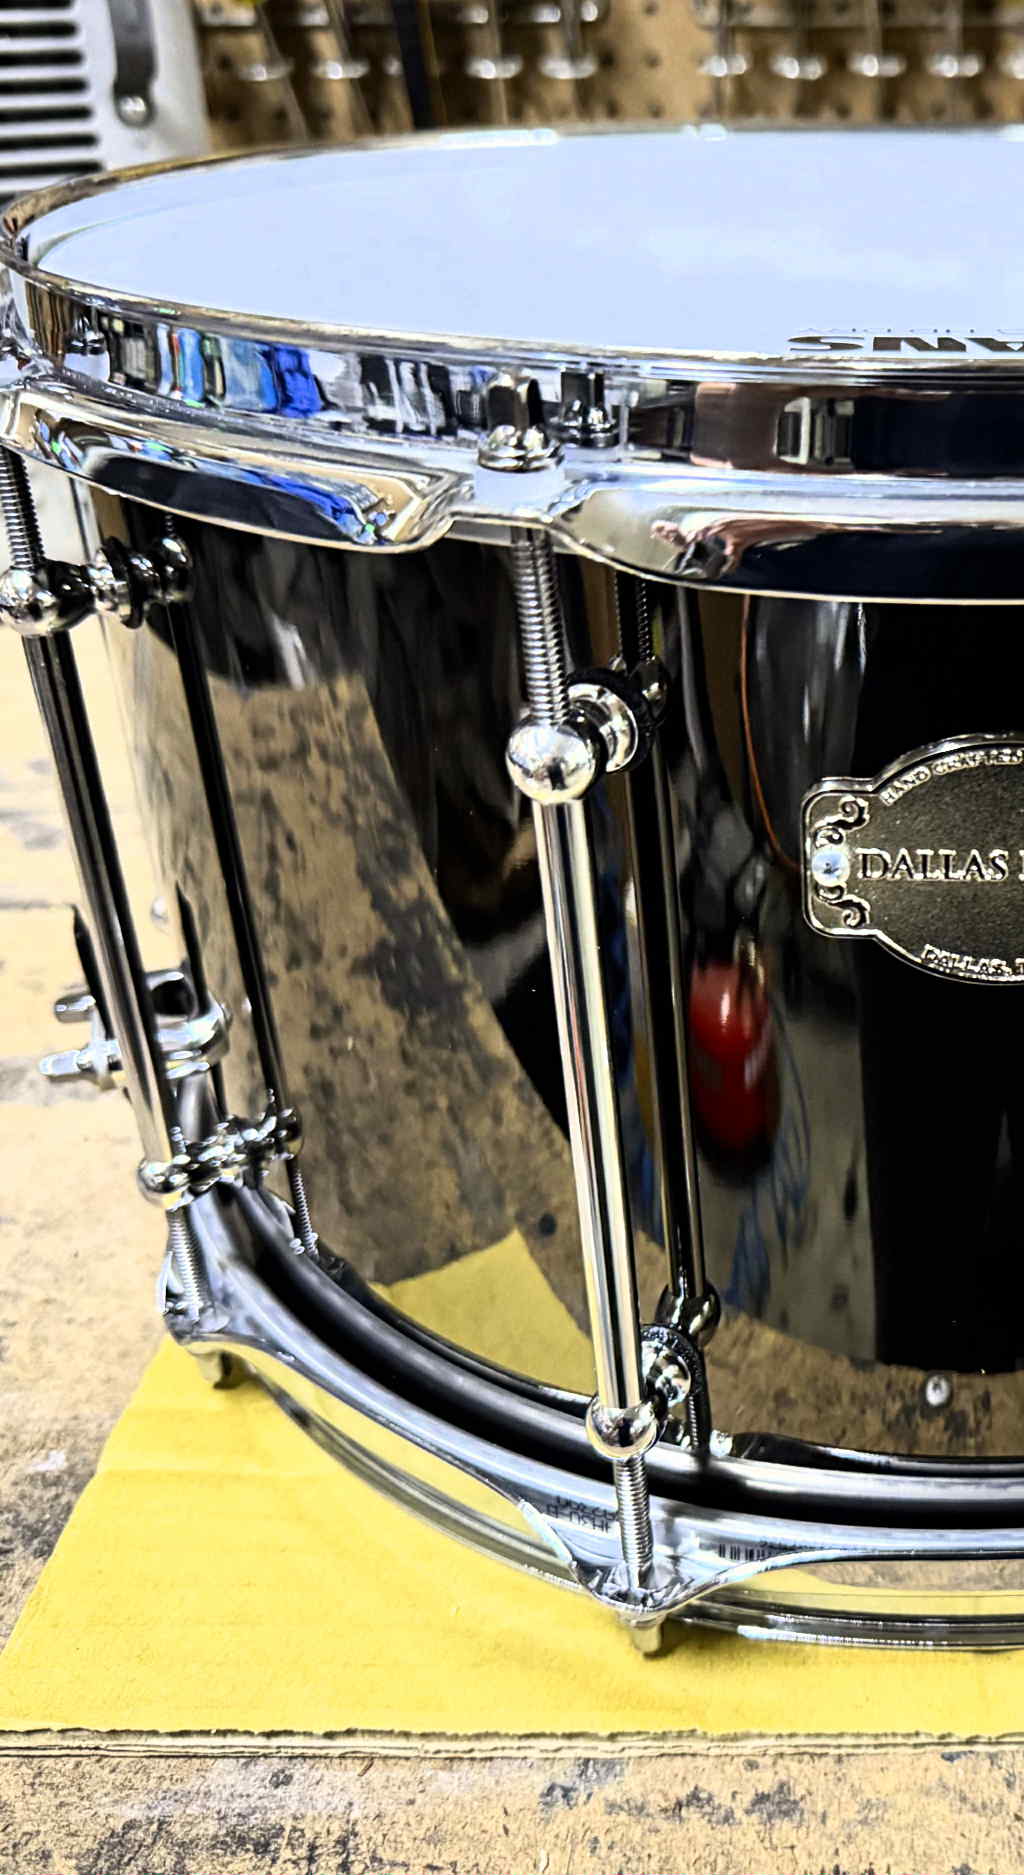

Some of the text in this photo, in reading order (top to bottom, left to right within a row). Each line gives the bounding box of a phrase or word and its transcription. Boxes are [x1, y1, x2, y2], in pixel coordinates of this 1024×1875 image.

[879, 764, 932, 806] HAND
[931, 748, 1023, 776] CRAFTED
[855, 847, 1009, 882] DALLAS
